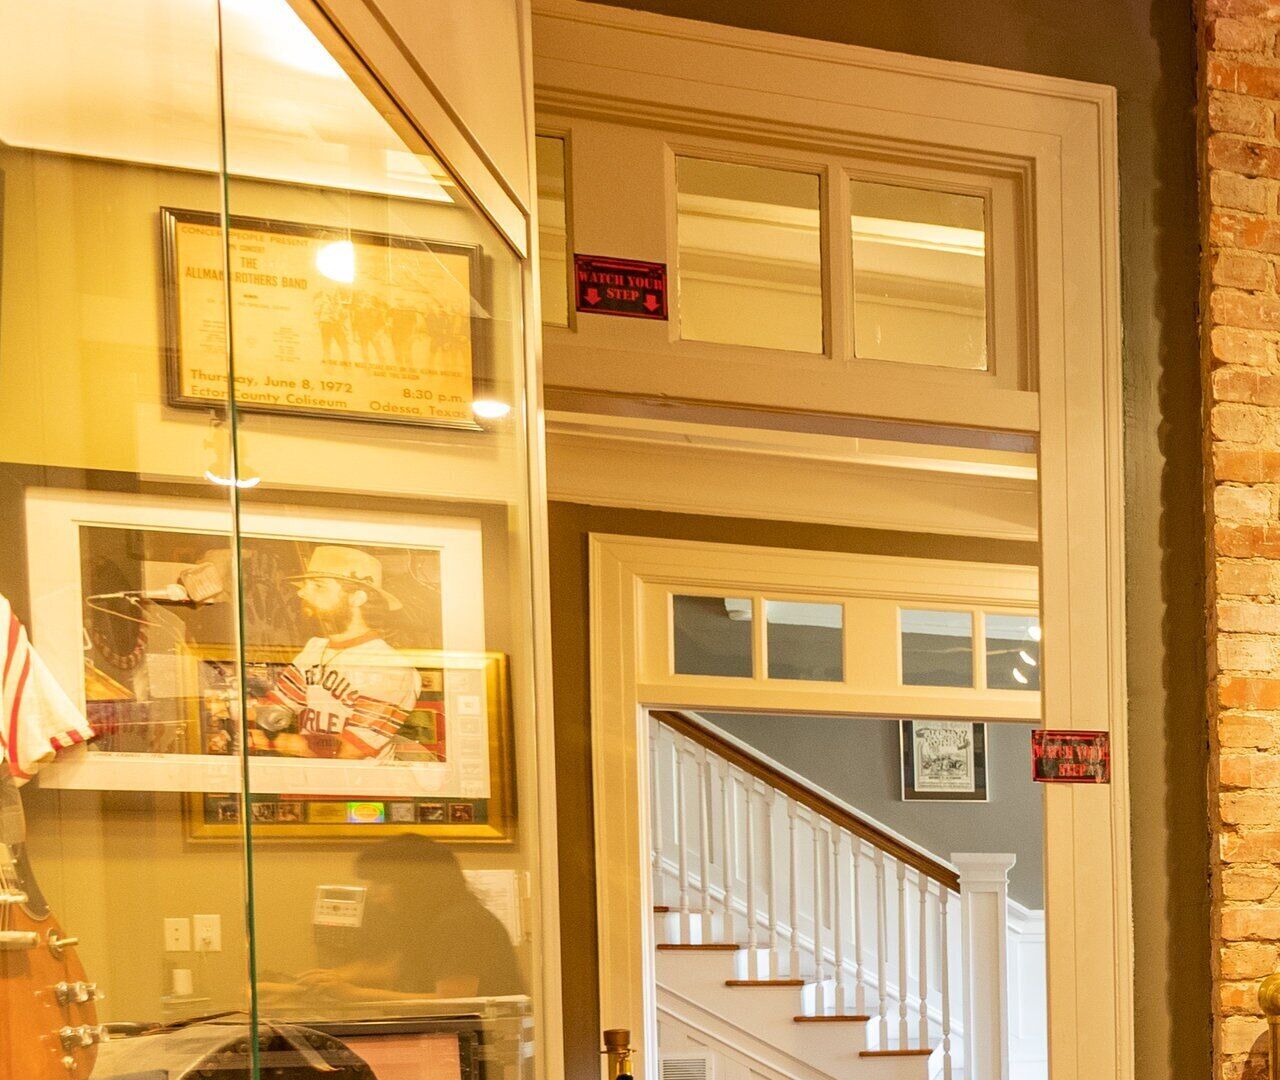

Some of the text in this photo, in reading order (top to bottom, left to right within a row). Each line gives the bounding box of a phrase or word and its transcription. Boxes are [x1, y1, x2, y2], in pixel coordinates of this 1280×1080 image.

[240, 256, 258, 270] THE
[234, 271, 279, 288] ROTHERS
[281, 276, 309, 290] BAND
[578, 271, 664, 291] WATCH YOUR
[606, 287, 640, 300] STEP
[190, 369, 353, 395] Thursay, June 8, 1972
[191, 385, 227, 400] Ector
[286, 393, 348, 410] Coliseum
[402, 388, 467, 405] 8:30 p.m.
[369, 400, 468, 419] Odessa, Texas
